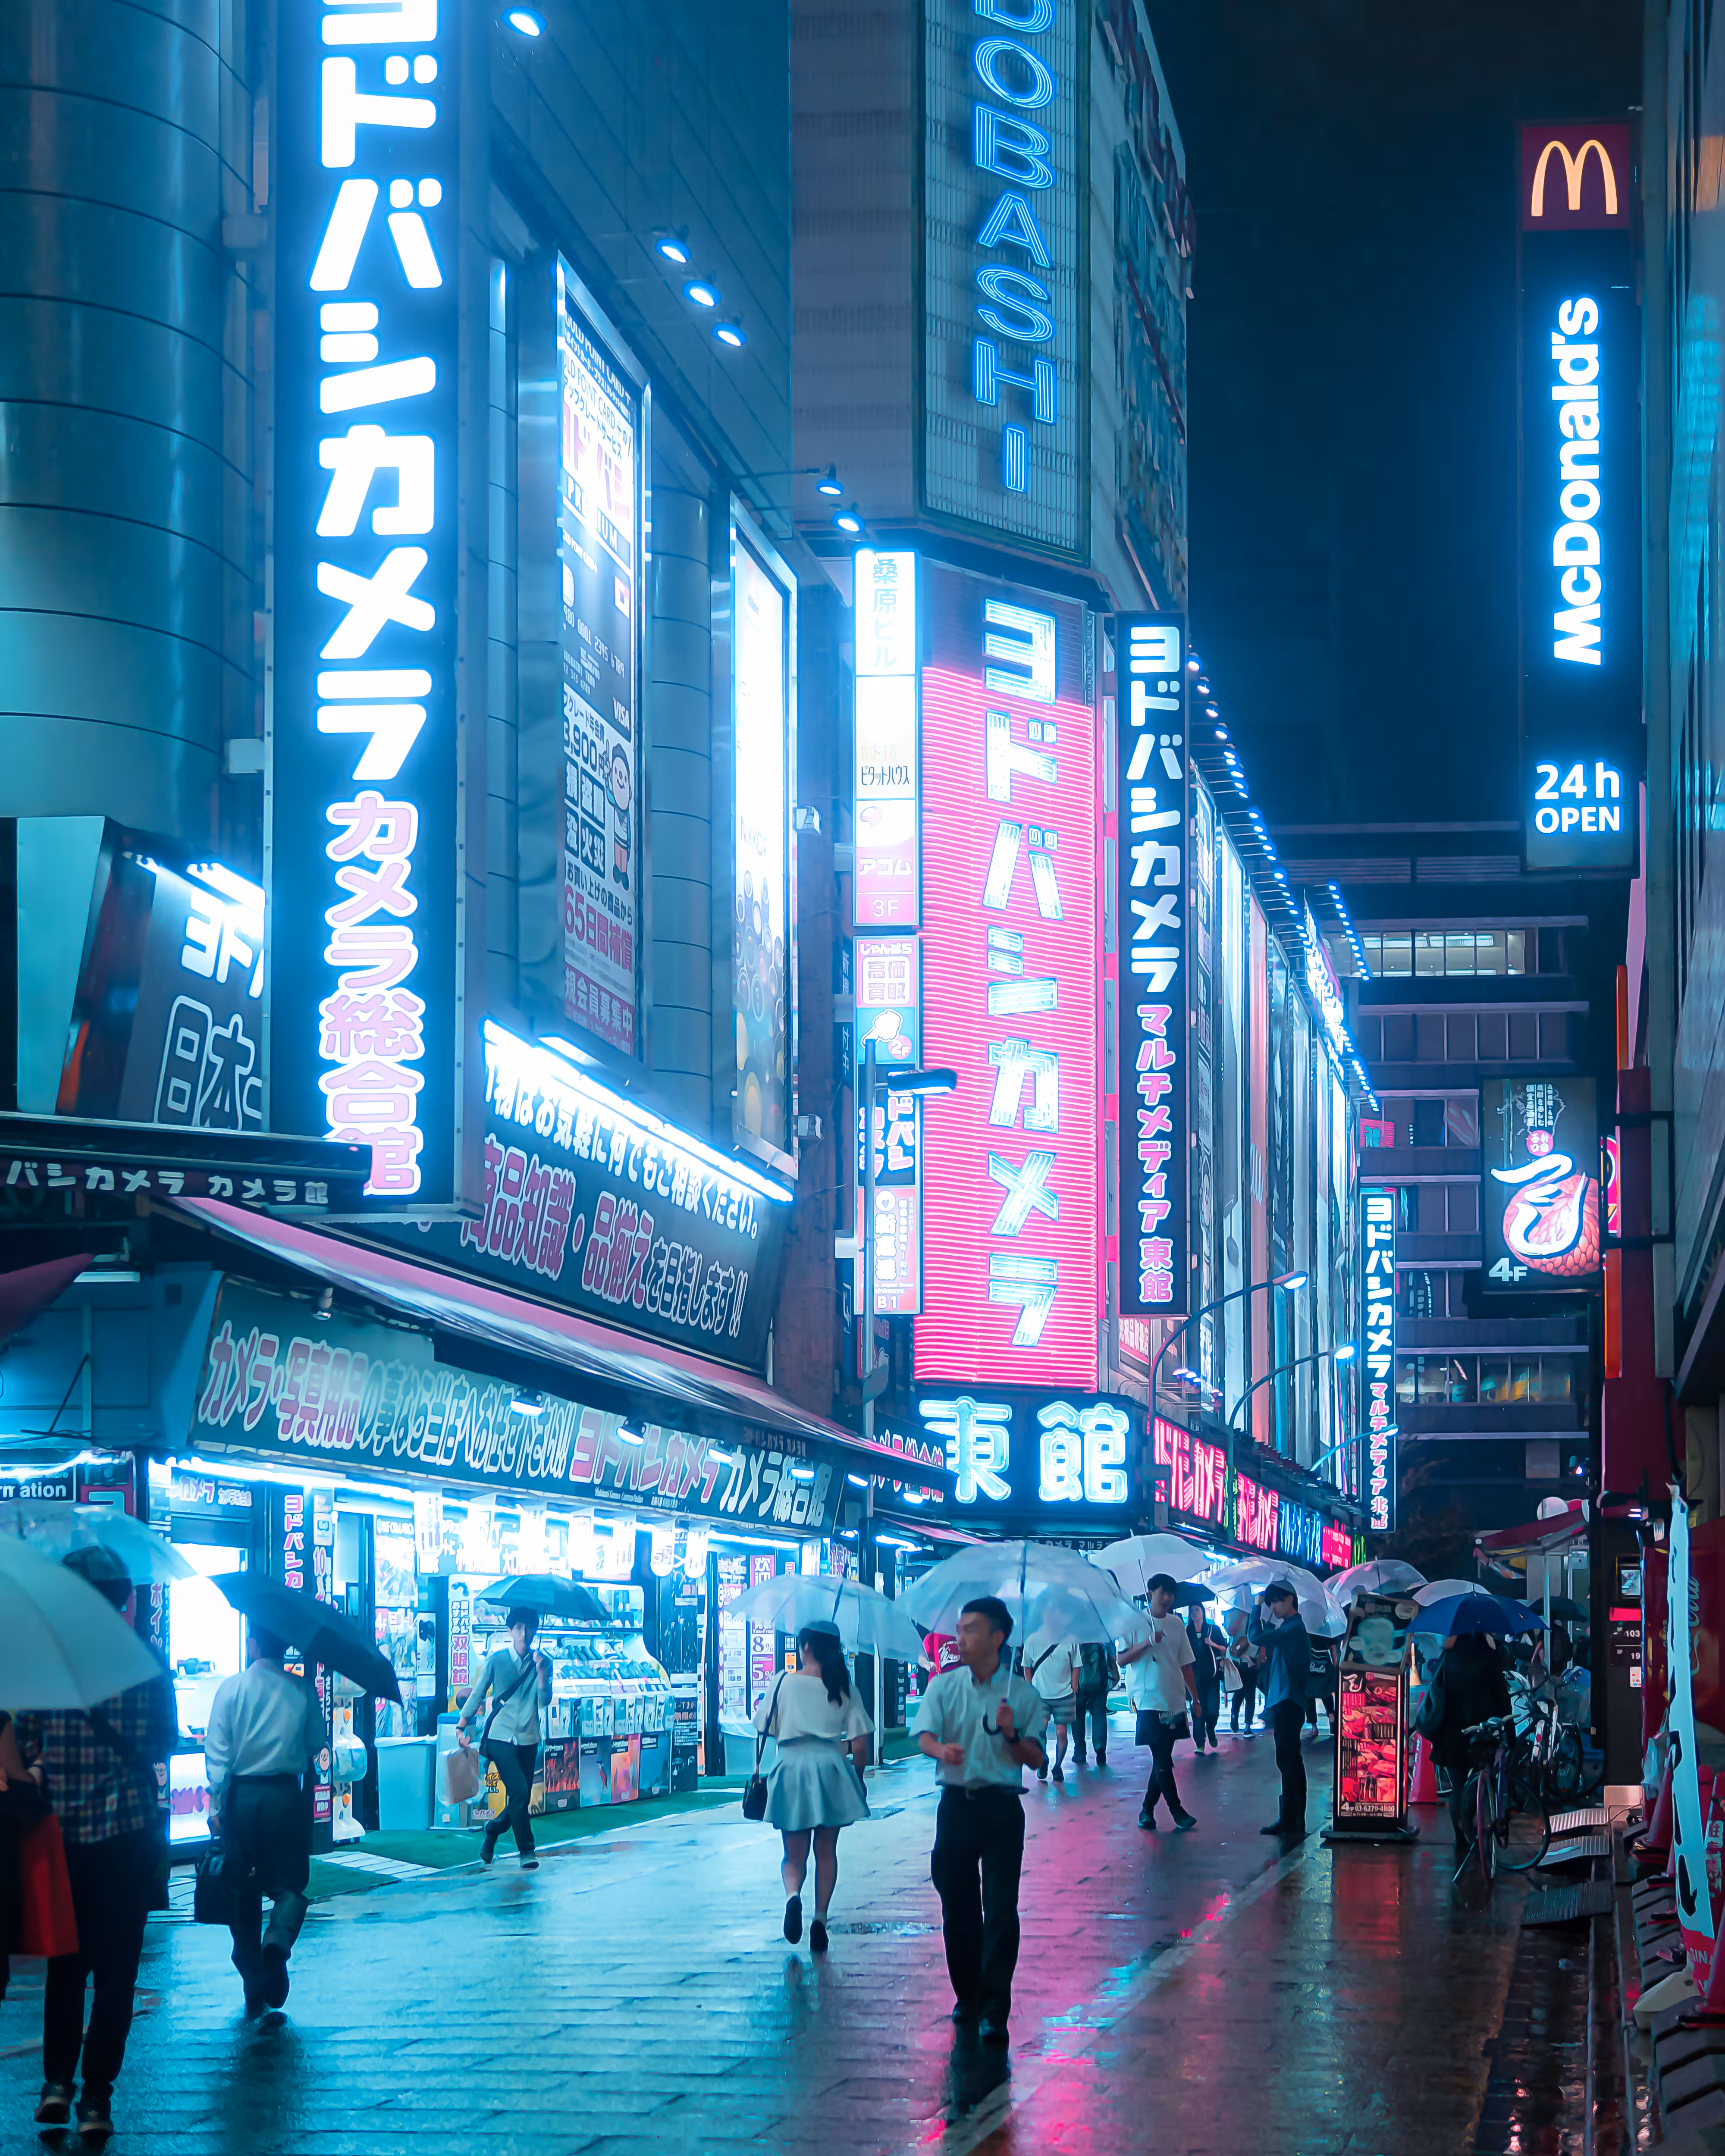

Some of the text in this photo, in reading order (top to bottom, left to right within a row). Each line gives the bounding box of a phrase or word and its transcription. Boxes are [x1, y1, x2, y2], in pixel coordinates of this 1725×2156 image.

[1552, 296, 1602, 667] McDonald's
[873, 559, 898, 668] 桑原ビル
[612, 696, 630, 731] VISA
[861, 765, 910, 786] ピタットハウス
[1534, 763, 1621, 800] 24h
[1535, 806, 1621, 834] OPEN
[858, 857, 913, 877] アコム
[567, 860, 633, 926] お買い上げの商品から
[872, 899, 900, 918] 3F
[868, 961, 905, 979] 高価
[982, 598, 1064, 1346] ヨドバシカメラ
[1126, 626, 1183, 1304] ヨドバシカメラ マルチメディア東館
[318, 790, 425, 1195] カメラ総合館
[868, 982, 905, 1001] 買取
[891, 1042, 910, 1056] 2F
[887, 1072, 919, 1171] ドバシ
[6, 1160, 329, 1204] バシカメラ カメラ館
[1365, 1197, 1394, 1379] ヨドバシカメラ
[1488, 1257, 1528, 1282] 4F
[569, 1407, 723, 1504] ヨドバシカメラ
[919, 1395, 1129, 1504] 東館
[283, 1494, 304, 1589] ヨドバシカ
[451, 1634, 470, 1686] 双眼鏡
[752, 1636, 774, 1652] 8%
[752, 1663, 773, 1680] 5%
